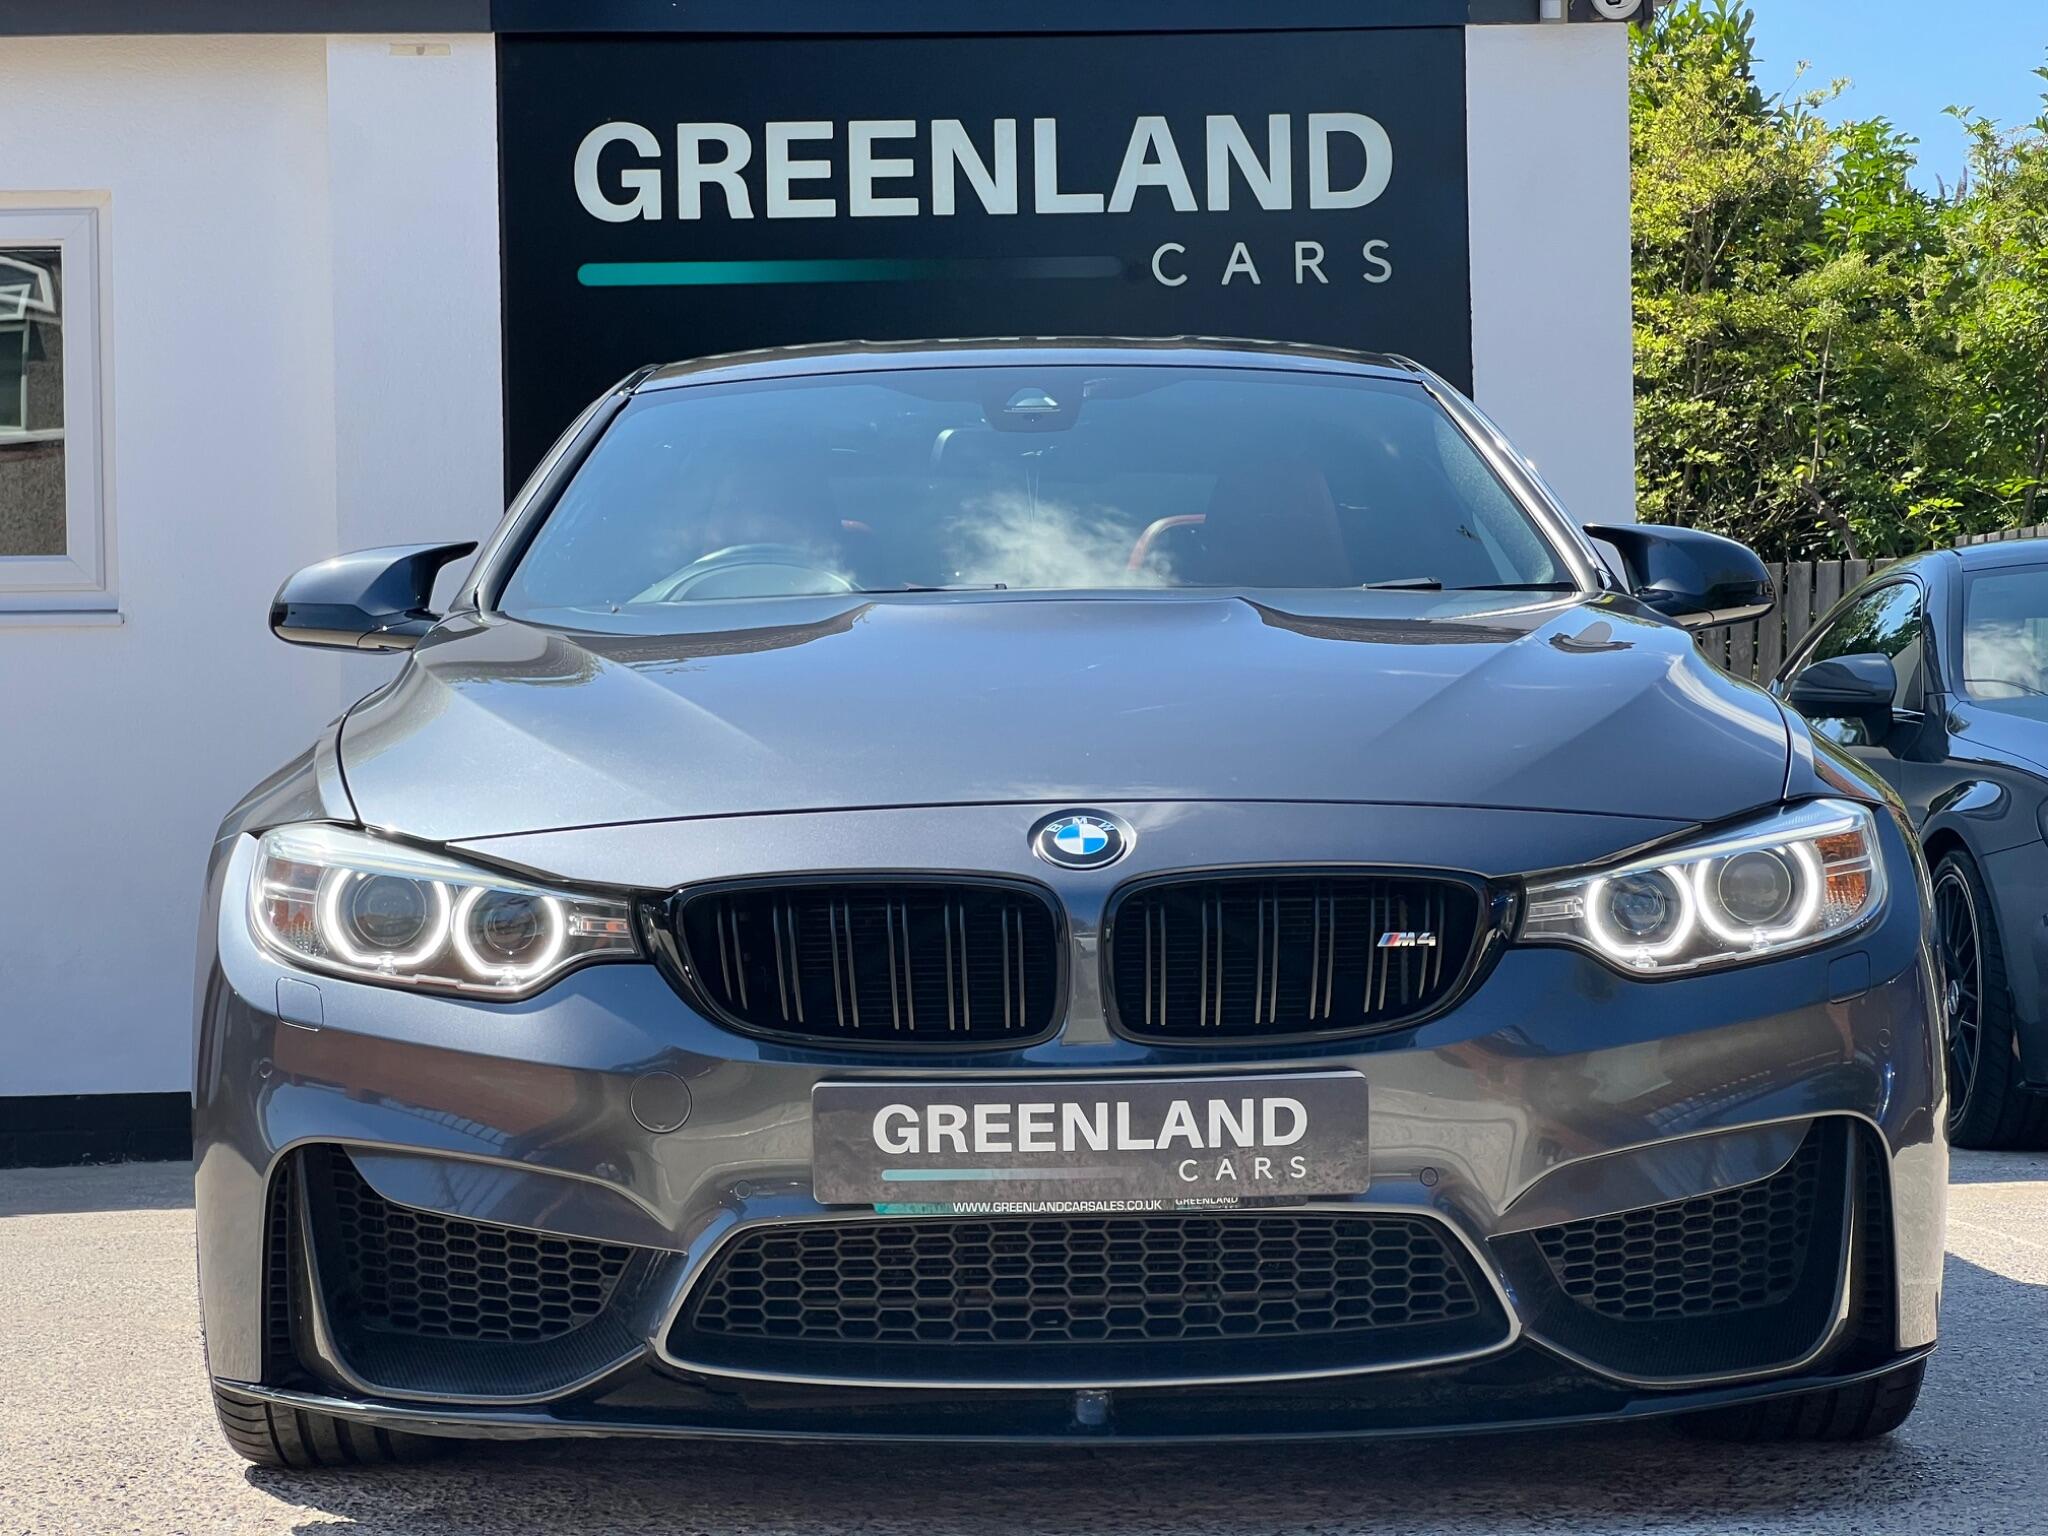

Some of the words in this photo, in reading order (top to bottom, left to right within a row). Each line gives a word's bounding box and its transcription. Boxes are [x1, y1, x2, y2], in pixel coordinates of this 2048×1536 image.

[574, 112, 1395, 223] GREENLAND
[1151, 239, 1394, 288] CARS
[1046, 816, 1115, 832] BMW
[1395, 932, 1436, 947] M4
[872, 1097, 1308, 1155] GREENLAND
[1178, 1156, 1306, 1182] CARS
[952, 1200, 1162, 1213] WWW.GREENLANDCARSALES.CO.UK
